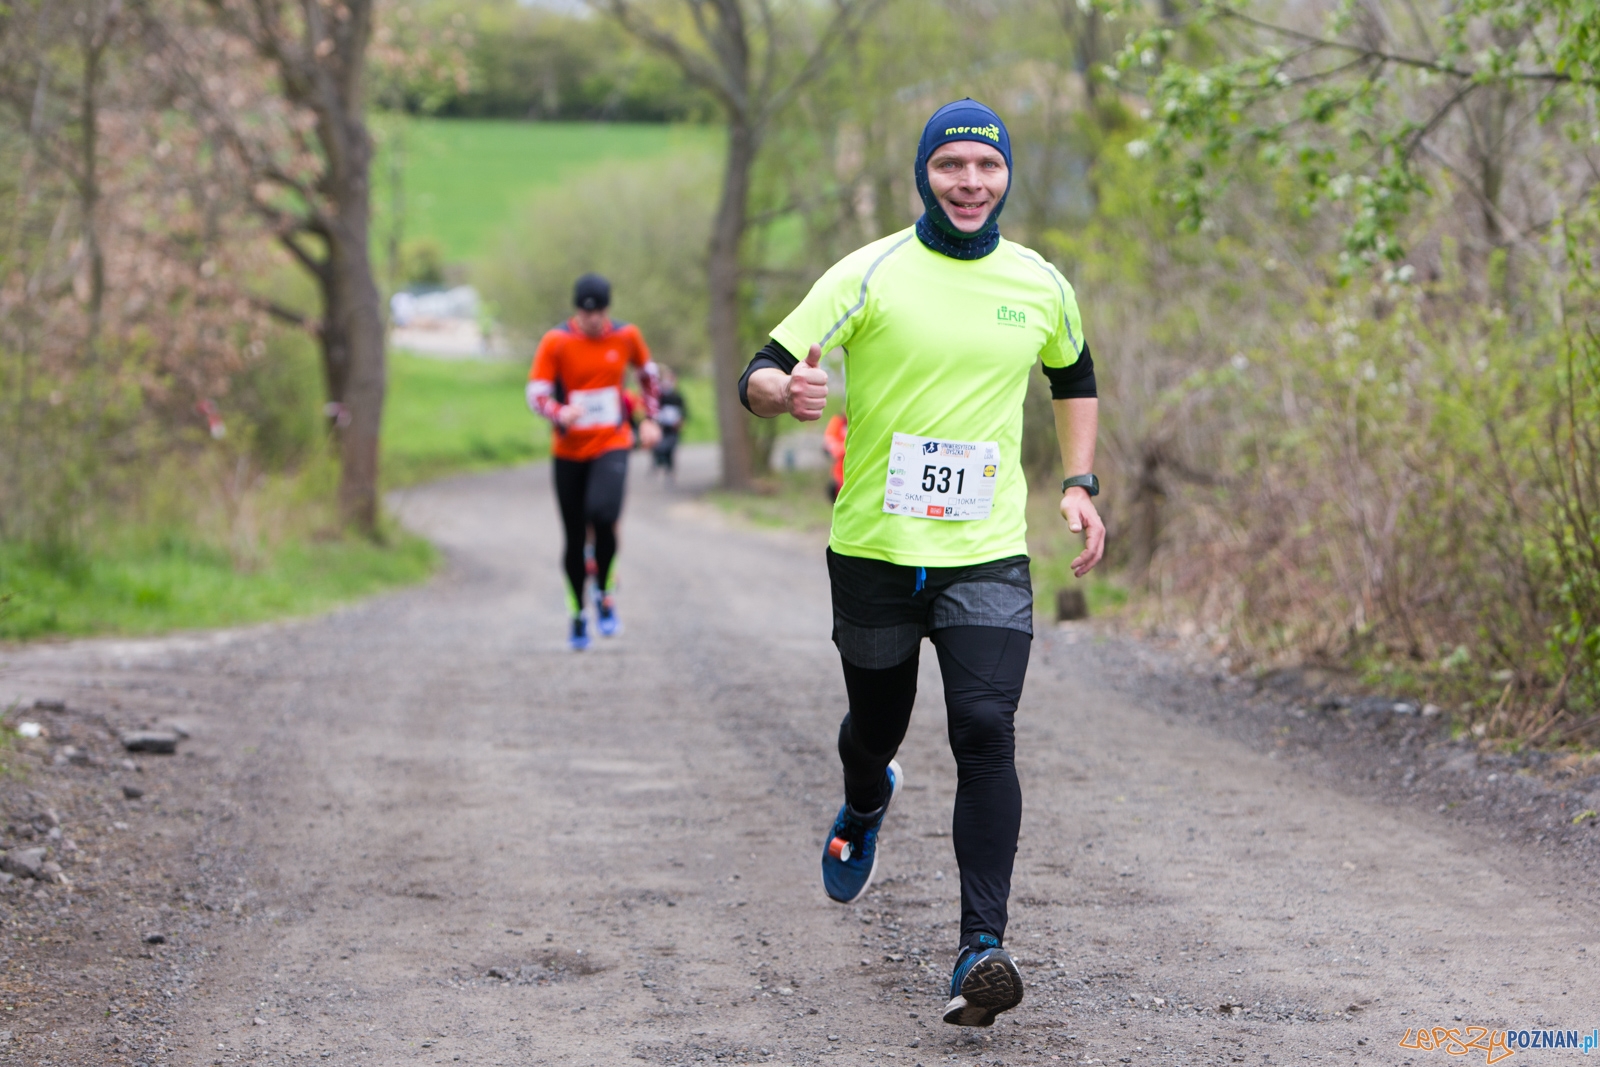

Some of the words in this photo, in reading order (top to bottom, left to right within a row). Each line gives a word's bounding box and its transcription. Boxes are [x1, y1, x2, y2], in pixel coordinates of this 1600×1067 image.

[945, 126, 999, 142] marathon
[921, 465, 965, 495] 531
[905, 493, 922, 502] 5KM
